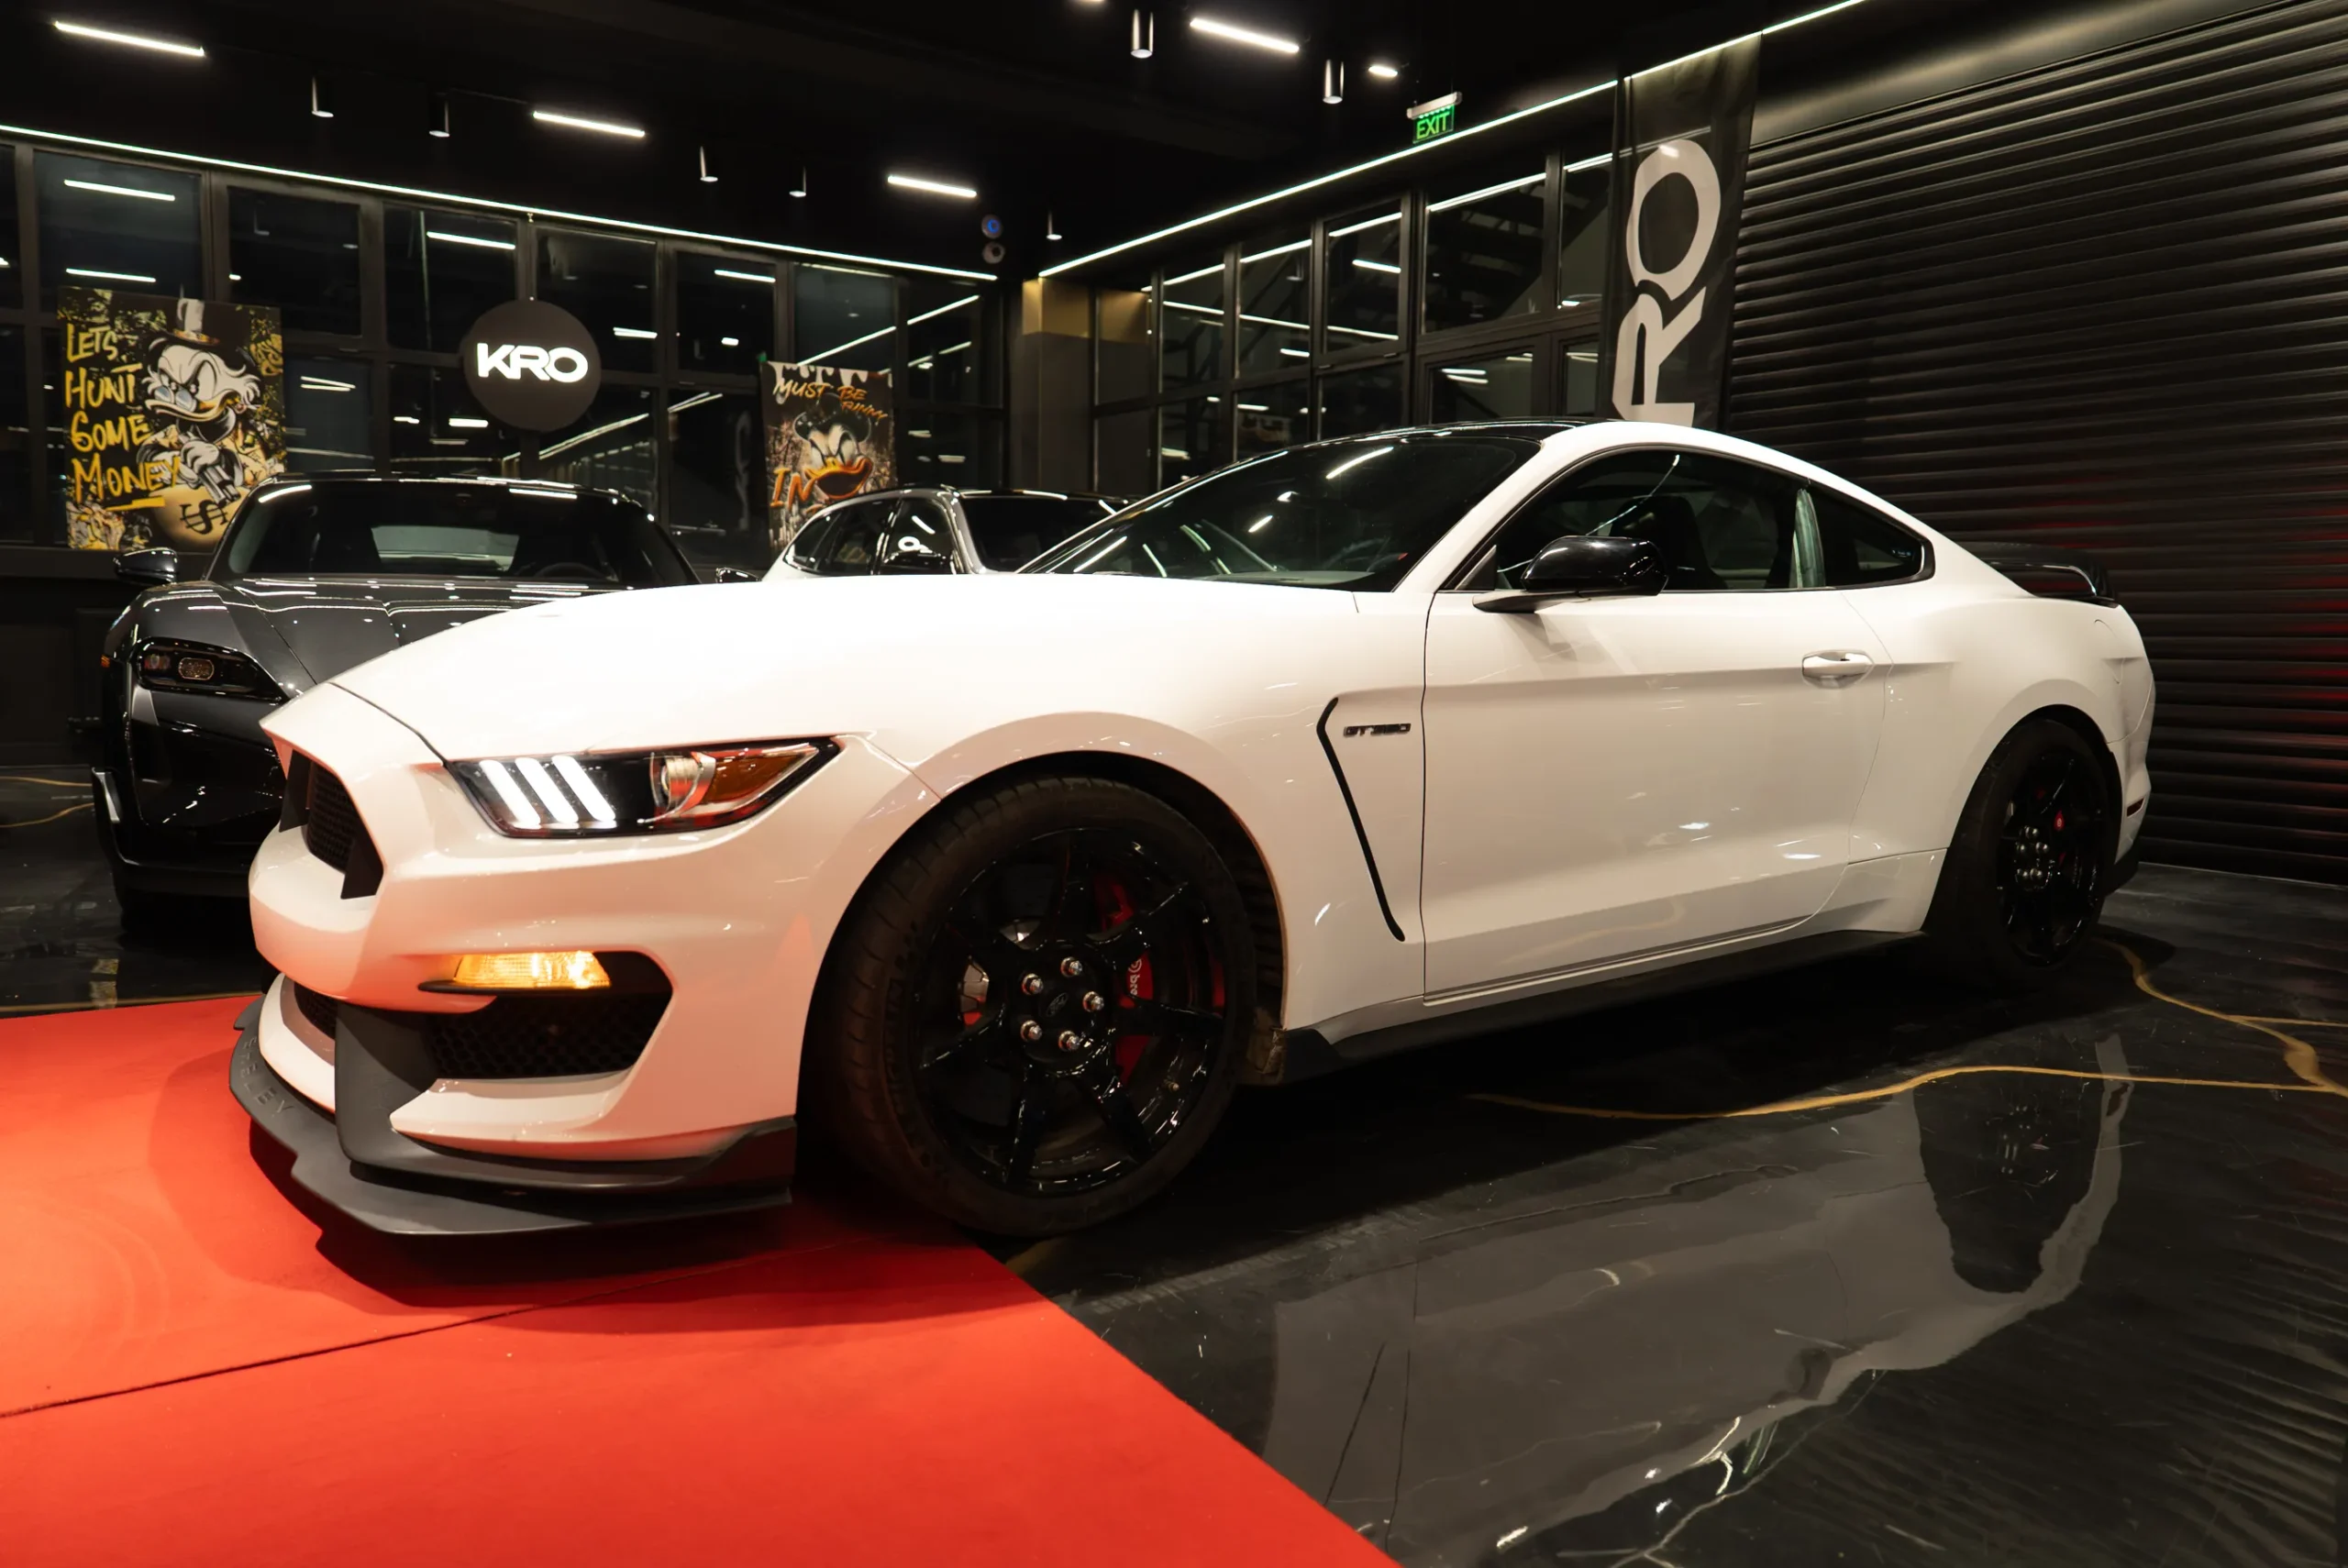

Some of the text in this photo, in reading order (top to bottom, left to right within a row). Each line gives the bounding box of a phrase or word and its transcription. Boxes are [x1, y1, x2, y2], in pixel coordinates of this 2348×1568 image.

[1417, 111, 1449, 139] EXIT
[1611, 138, 1722, 428] RO
[67, 324, 118, 363] LETS
[477, 343, 588, 382] KRO
[65, 364, 142, 409] HUNT
[772, 378, 868, 402] MUST BE
[72, 453, 182, 504] MONEY
[770, 468, 816, 511] IN
